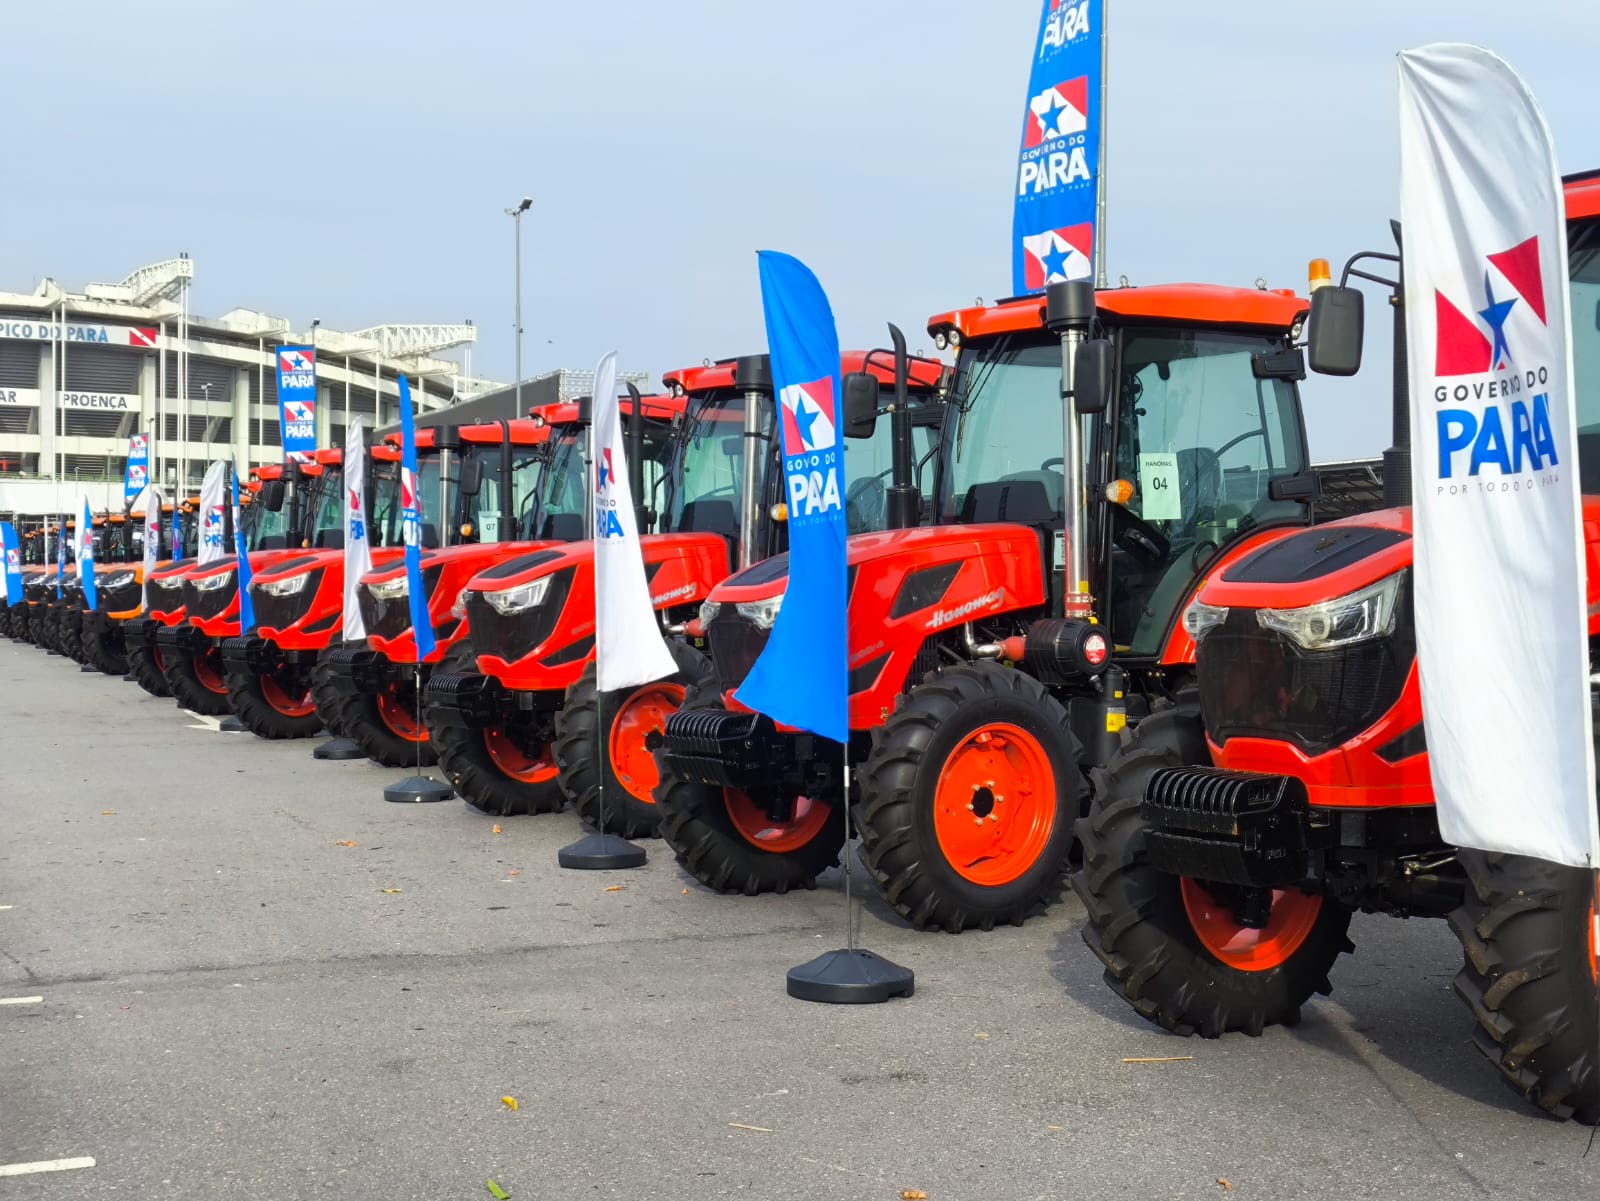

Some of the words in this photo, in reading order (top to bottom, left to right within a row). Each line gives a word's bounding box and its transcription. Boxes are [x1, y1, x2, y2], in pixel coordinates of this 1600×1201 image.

[1069, 134, 1085, 146] DO
[39, 325, 60, 339] DO
[66, 326, 109, 342] PARÁ
[1434, 375, 1521, 402] GOVERNO
[1526, 366, 1548, 388] DO
[64, 393, 128, 409] PROENÇA
[825, 451, 836, 465] DO
[1153, 477, 1169, 490] 04
[1437, 484, 1468, 496] POR
[1527, 479, 1533, 490] O
[486, 523, 496, 531] 07
[925, 586, 1006, 628] Hanomag
